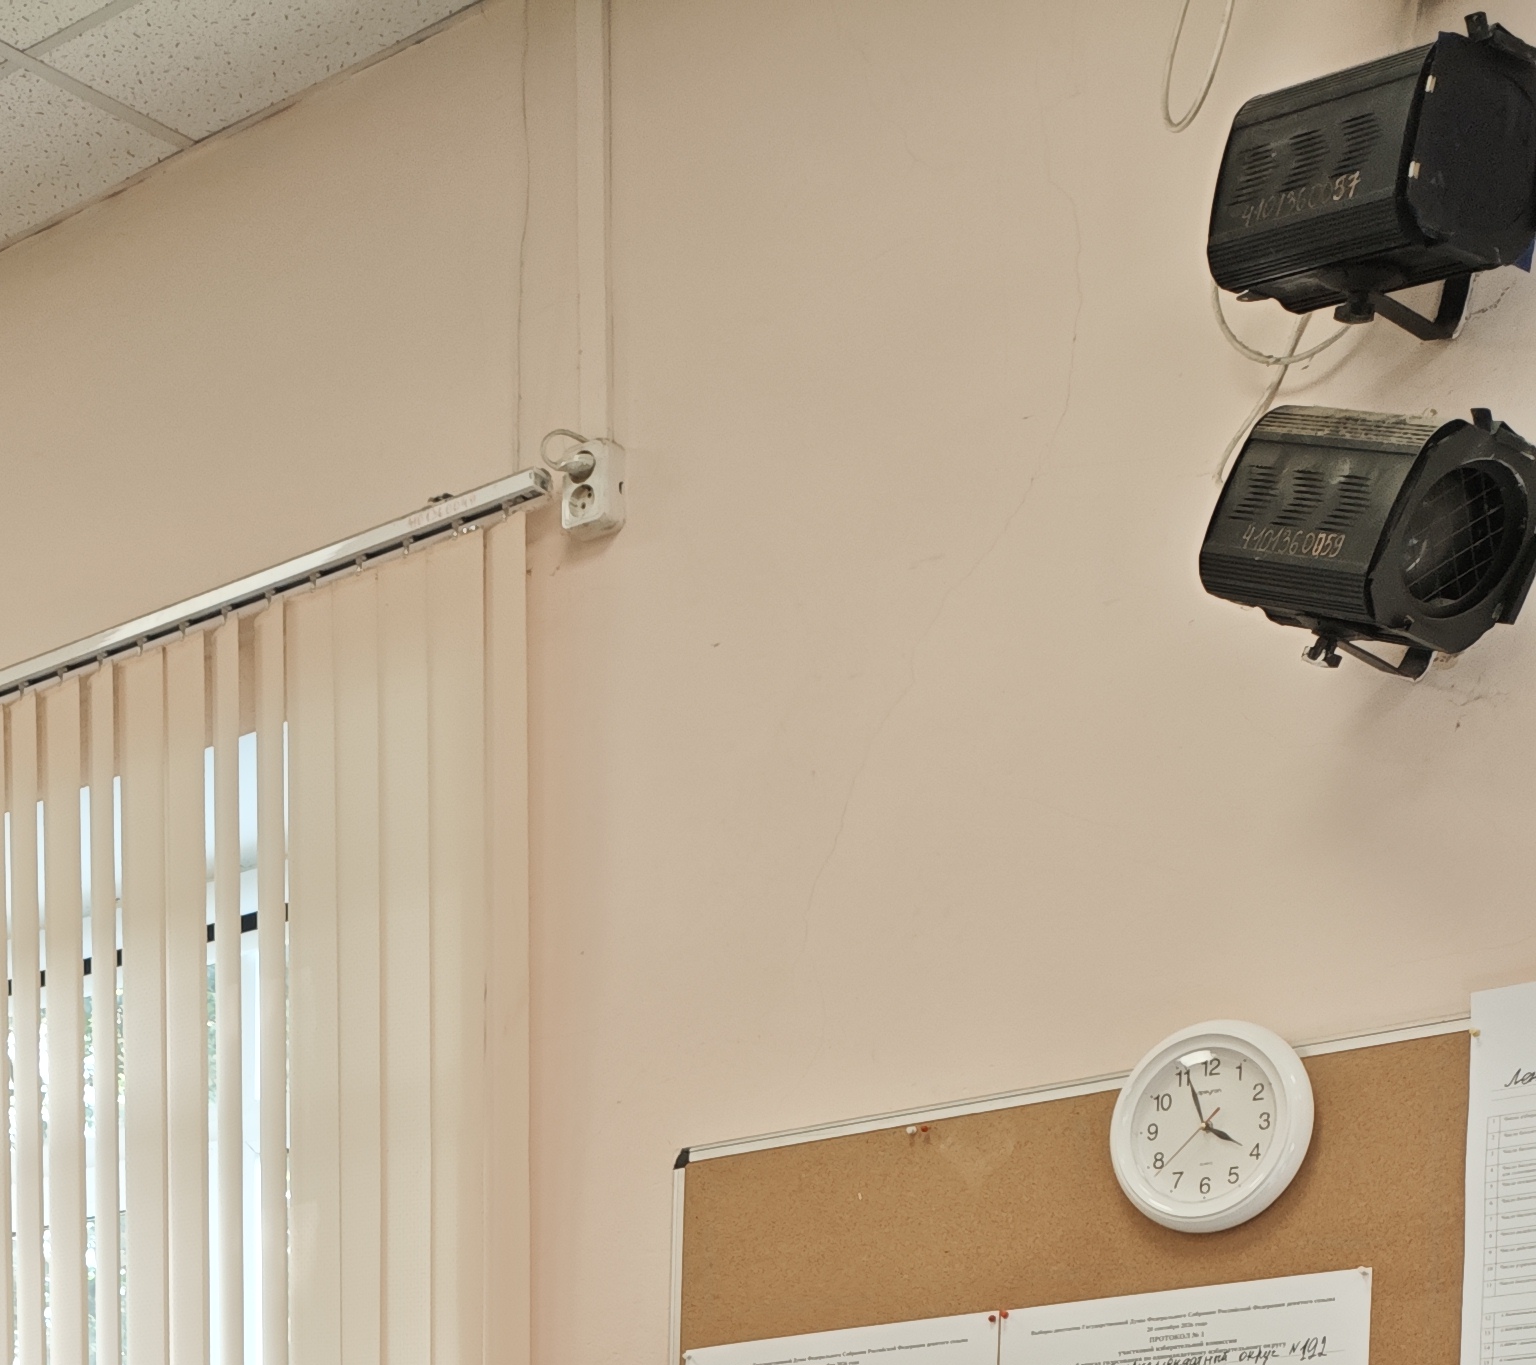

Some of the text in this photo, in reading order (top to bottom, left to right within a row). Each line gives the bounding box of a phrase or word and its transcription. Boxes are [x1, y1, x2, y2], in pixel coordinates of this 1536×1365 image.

[1201, 1057, 1221, 1077] 12
[1235, 1063, 1243, 1081] 1
[1175, 1069, 1191, 1087] 11
[1252, 1083, 1264, 1101] 2
[1154, 1093, 1173, 1112] 10
[1258, 1112, 1271, 1130] 3
[1147, 1123, 1159, 1141] 9
[1249, 1142, 1261, 1160] 4
[1153, 1152, 1165, 1170] 8
[1172, 1171, 1184, 1189] 7
[1227, 1166, 1240, 1184] 5
[1199, 1177, 1211, 1194] 6
